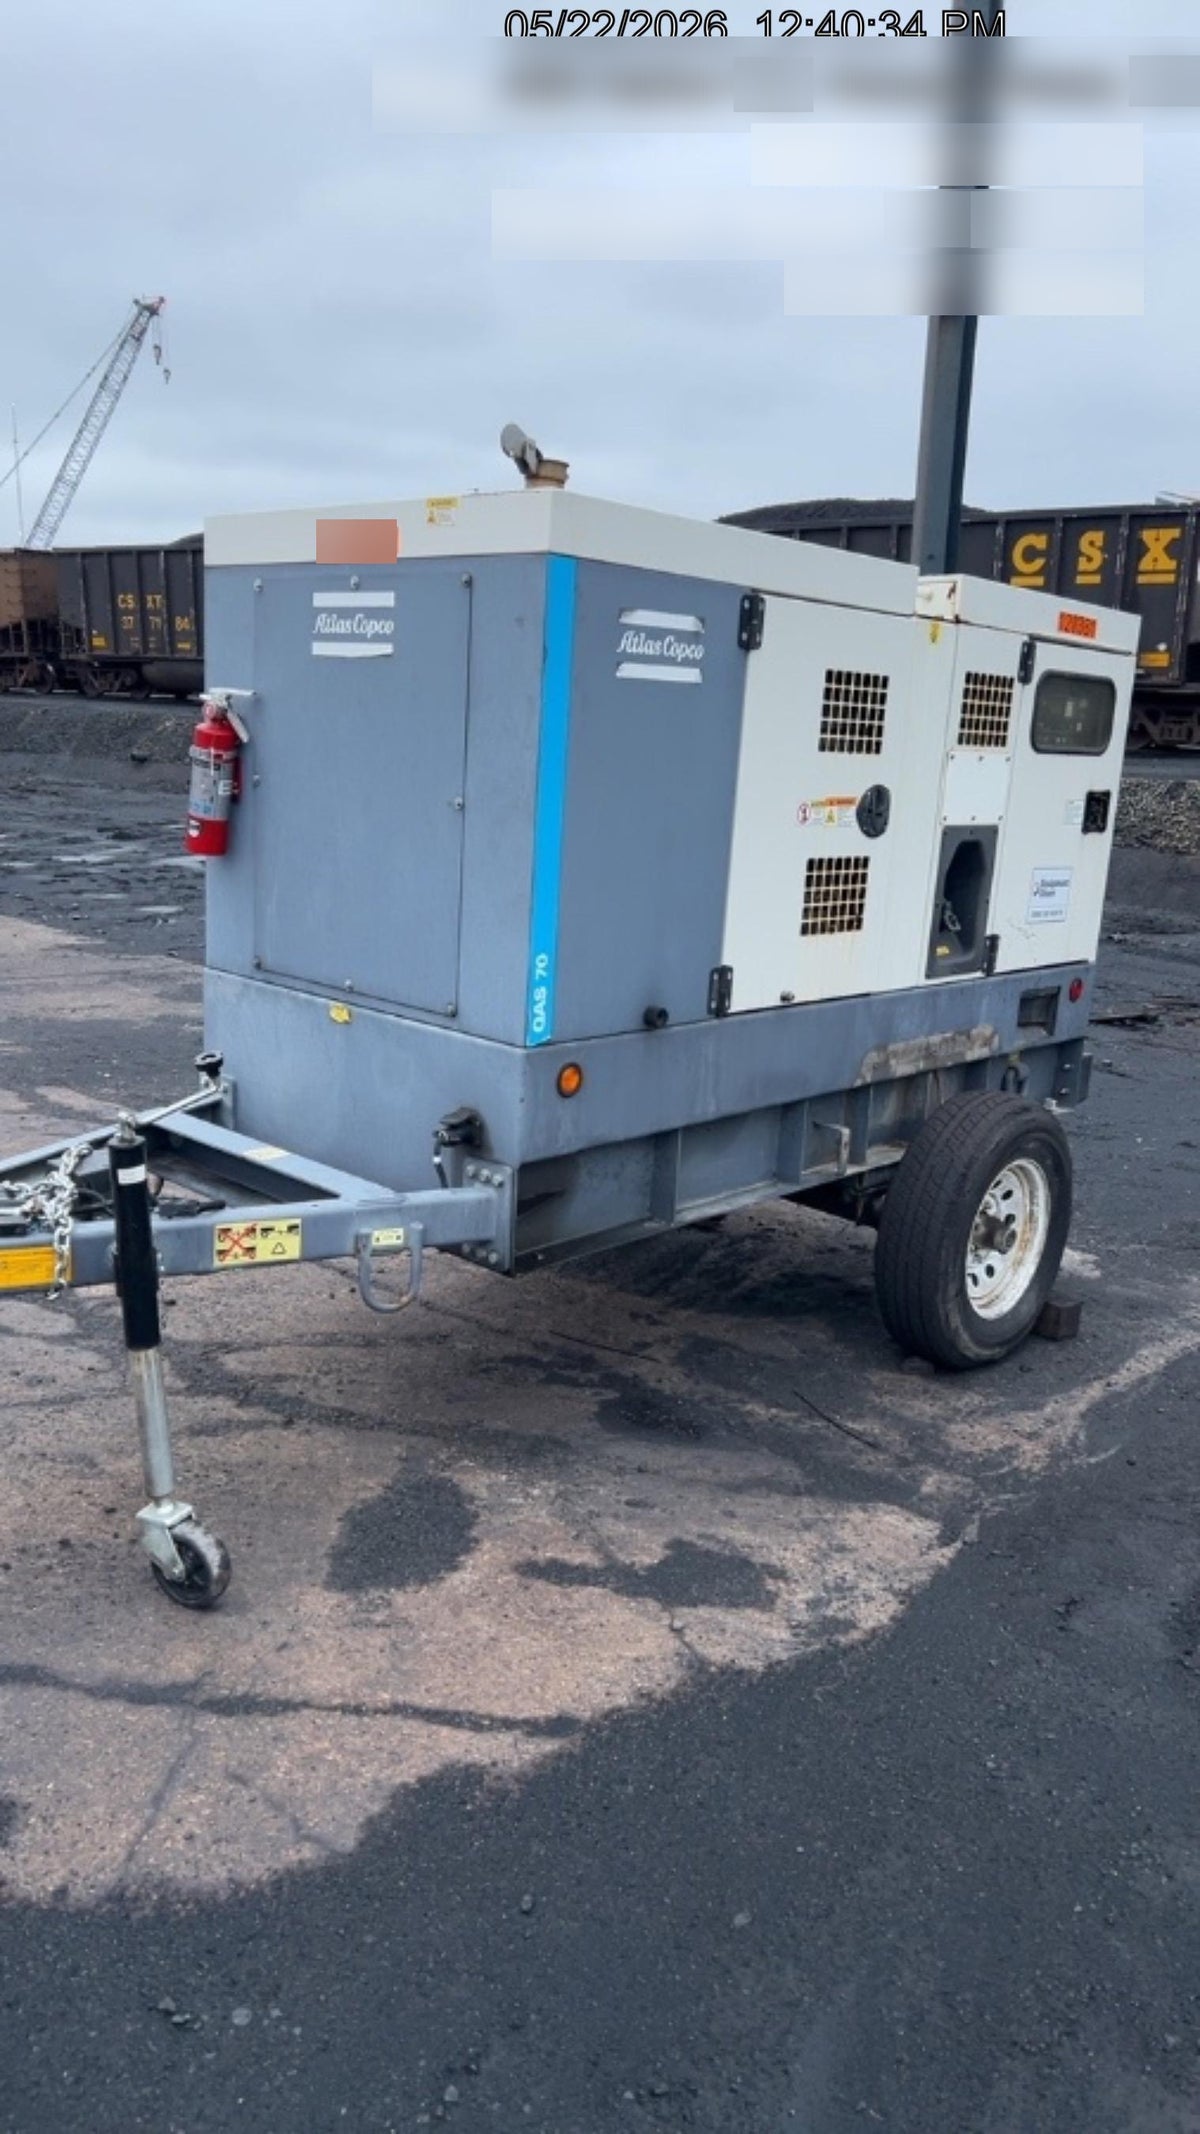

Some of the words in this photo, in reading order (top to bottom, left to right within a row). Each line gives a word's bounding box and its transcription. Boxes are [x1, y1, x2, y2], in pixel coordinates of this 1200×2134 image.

[312, 613, 351, 634] Atlas
[352, 613, 395, 638] Copco
[616, 630, 662, 655] Atlas
[664, 634, 705, 662] Copco
[535, 953, 549, 981] 70
